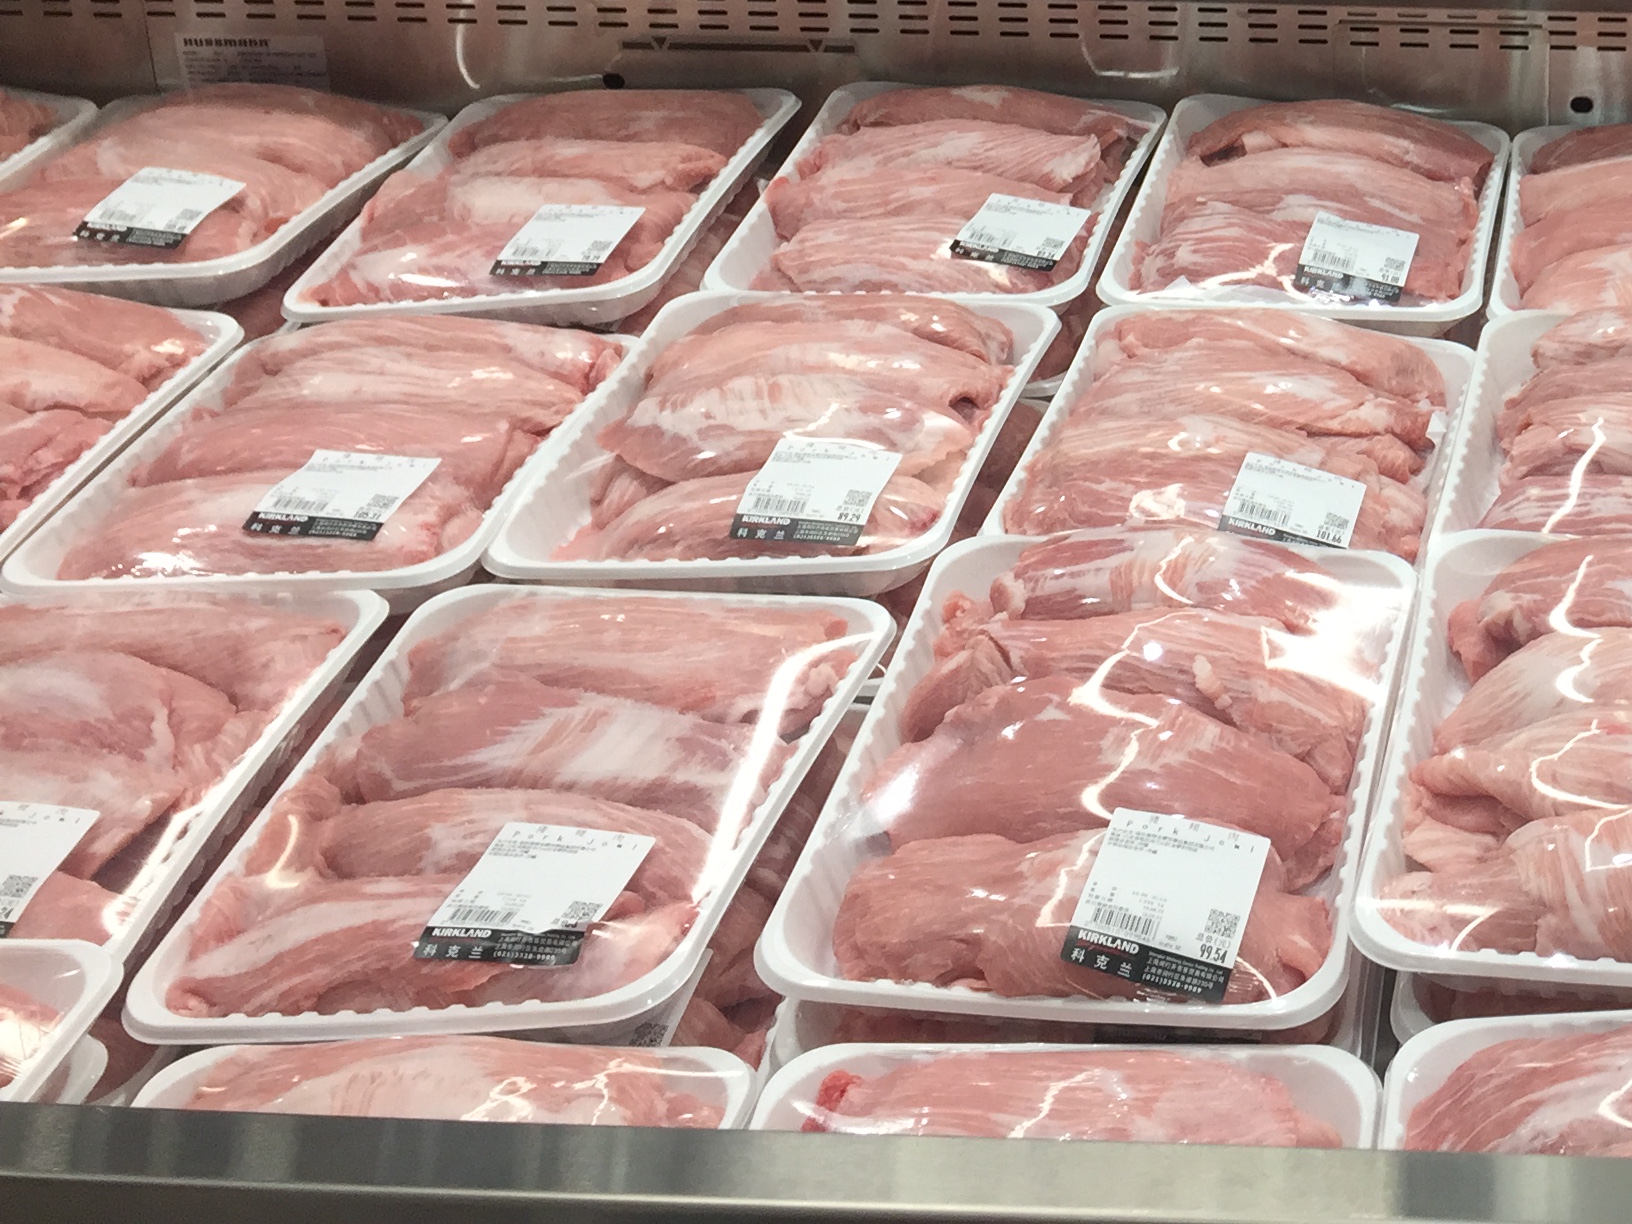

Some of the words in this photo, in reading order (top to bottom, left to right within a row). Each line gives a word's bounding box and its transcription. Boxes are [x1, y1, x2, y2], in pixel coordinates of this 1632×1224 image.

[742, 515, 791, 525] KIRKLAND
[1229, 518, 1276, 536] KIRKLAND
[1126, 820, 1179, 836] Pork
[1203, 834, 1255, 854] Jowl
[432, 927, 492, 939] KIRKLAND
[1077, 929, 1140, 955] KIRKLAND
[1070, 947, 1134, 978] 科克兰
[1200, 943, 1228, 964] 99.54
